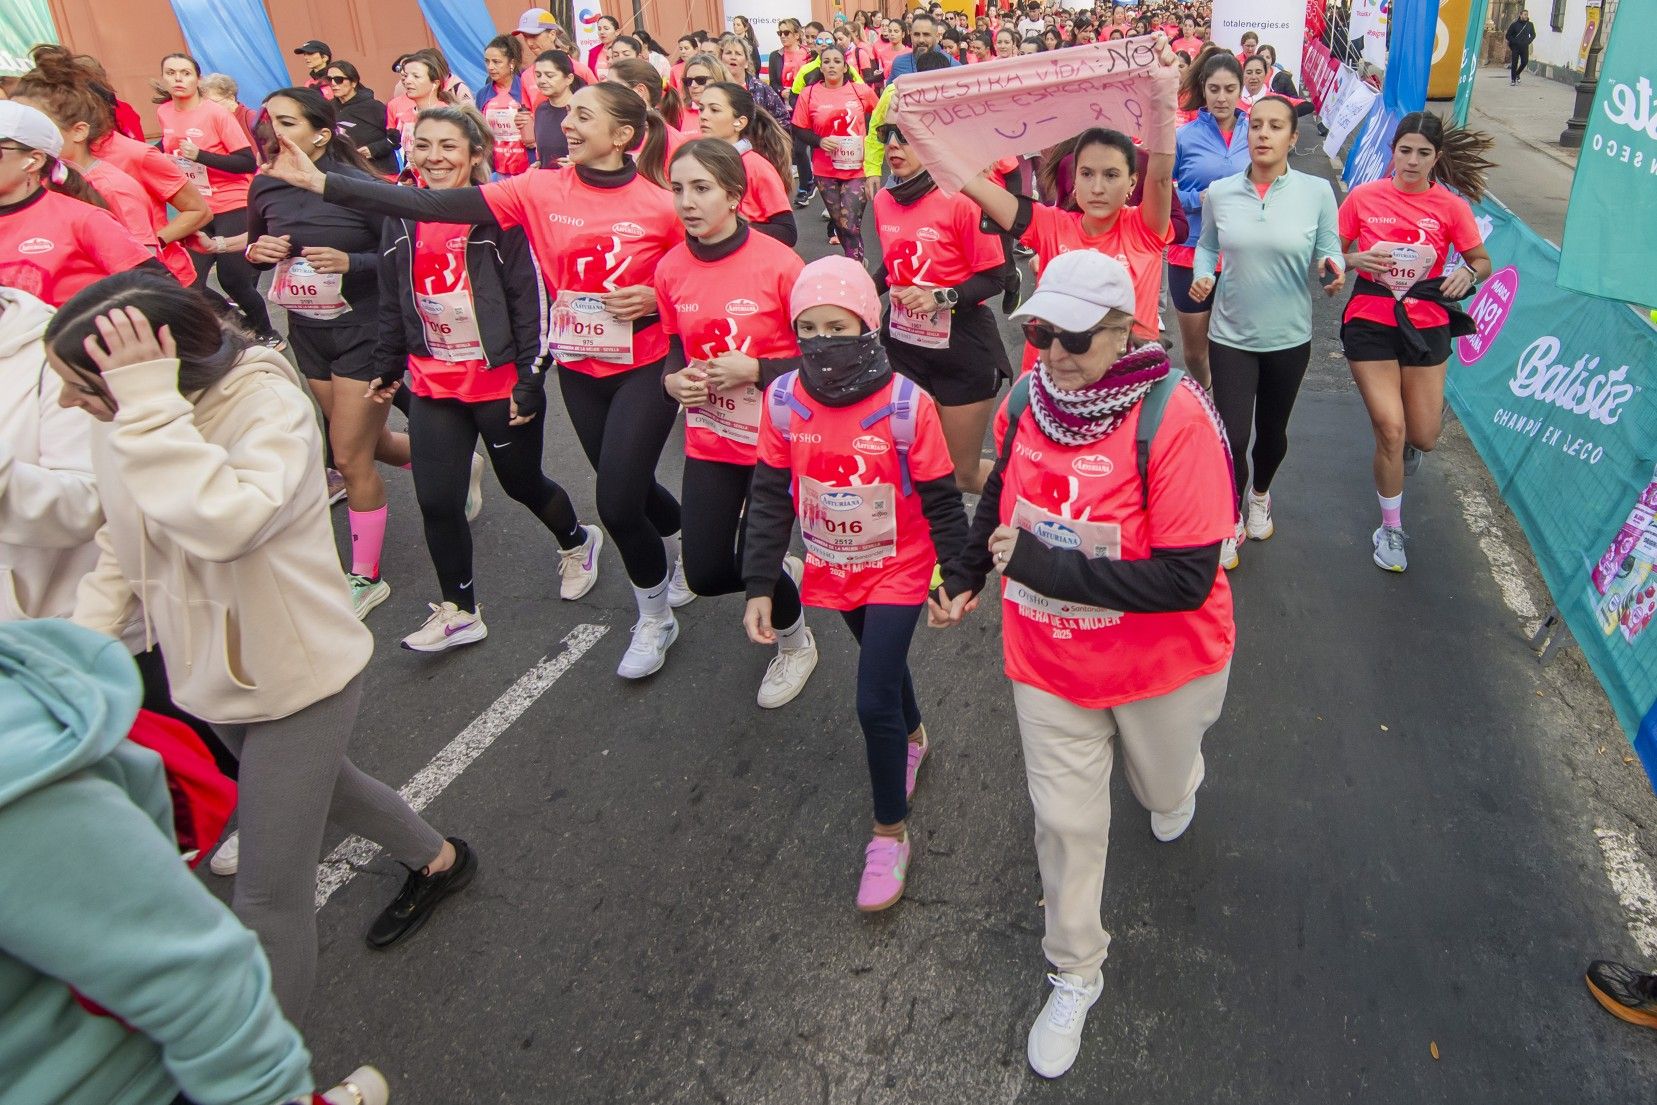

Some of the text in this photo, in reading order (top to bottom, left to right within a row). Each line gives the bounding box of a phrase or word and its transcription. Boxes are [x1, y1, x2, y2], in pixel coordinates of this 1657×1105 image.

[1223, 20, 1290, 30] totalenergies.es
[1107, 40, 1157, 72] NO
[919, 78, 1137, 136] PUEDE ESPERAR
[185, 172, 196, 180] 16
[549, 213, 584, 227] OYSHO
[1368, 216, 1397, 224] OYSHO
[1390, 267, 1416, 278] 016
[290, 284, 317, 296] 016
[1491, 279, 1511, 304] MARCA
[676, 303, 699, 312] YSHO
[429, 321, 452, 334] 016
[574, 322, 604, 335] 016
[1508, 335, 1634, 426] Batiste
[708, 393, 736, 411] 016
[1493, 408, 1604, 464] CHAMPÚ EN SECO
[823, 496, 860, 507] ASTURIANA
[825, 519, 863, 534] 016
[1036, 526, 1078, 546] ASTURIANA
[854, 550, 884, 560] Santander
[830, 567, 846, 580] 2025
[1018, 588, 1108, 613] OYSHO Santander
[1018, 604, 1121, 632] RRERA DE LA MUJER
[1052, 628, 1073, 640] 2025
